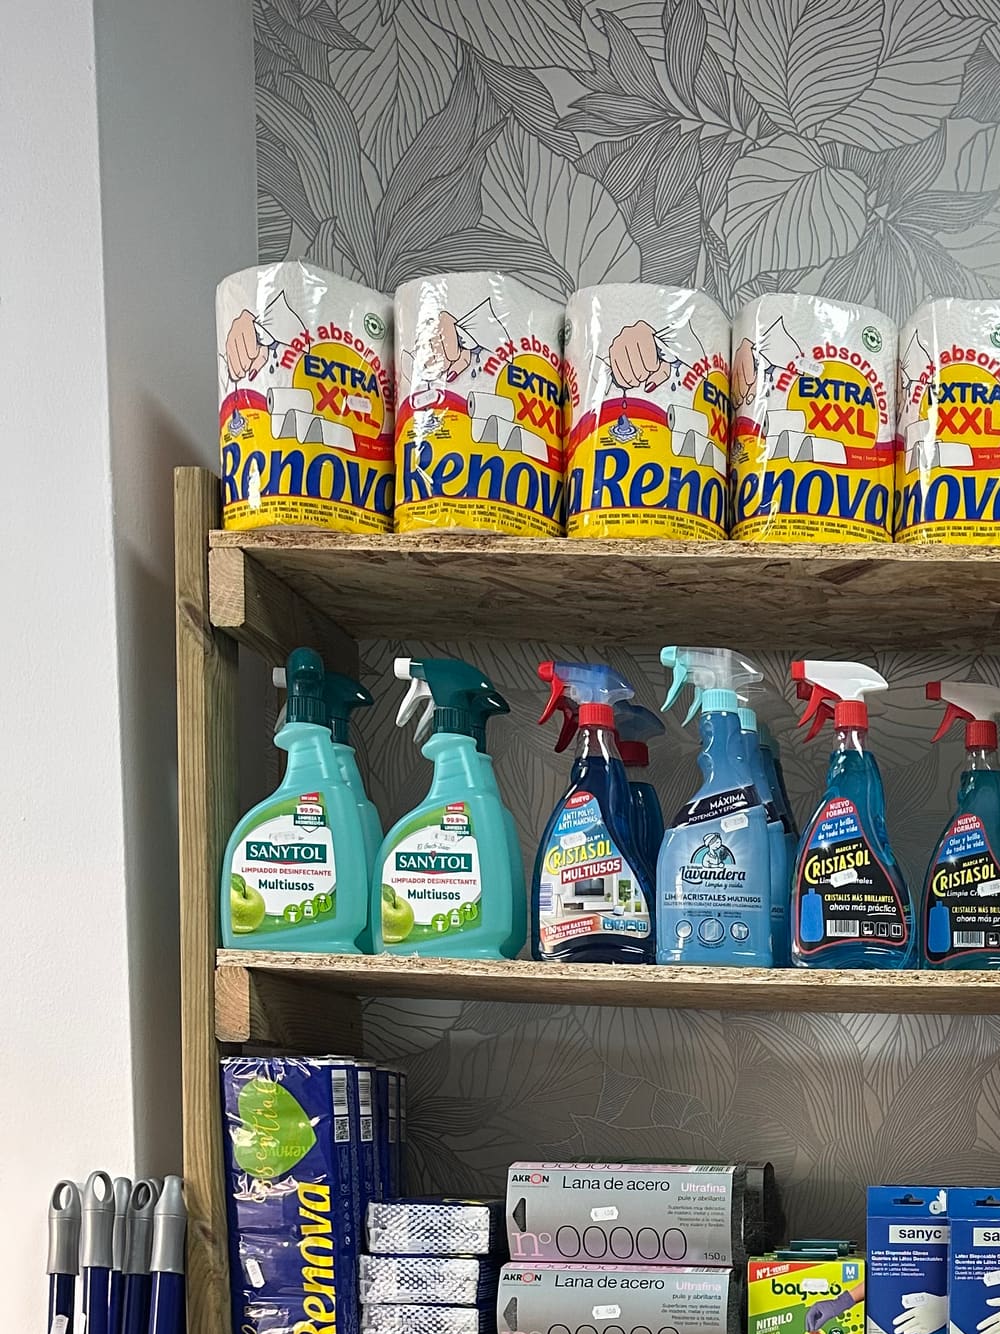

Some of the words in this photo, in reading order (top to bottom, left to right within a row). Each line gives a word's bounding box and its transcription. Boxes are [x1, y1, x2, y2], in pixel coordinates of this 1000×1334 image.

[279, 330, 313, 370] max
[304, 355, 380, 396] EXTRA
[710, 793, 746, 811] MÁXIMA
[954, 822, 980, 833] FORMATO
[958, 816, 976, 826] NUEVO
[249, 844, 323, 860] SANYTOL
[547, 842, 612, 874] CRISTASOL
[399, 856, 468, 869] SANYTOL
[805, 850, 870, 884] CRISTASOL
[280, 868, 332, 877] DESINFECTANTE
[562, 860, 621, 883] MULTIUSOS
[681, 867, 746, 884] Lavandera
[258, 879, 314, 891] Multiusos
[932, 863, 996, 896] CRISTASOL
[407, 889, 460, 900] Multiusos
[824, 894, 850, 902] CRISTALES
[866, 894, 894, 903] BRILLANTES
[868, 904, 896, 913] práctico
[512, 1173, 549, 1184] AKRON
[562, 1176, 601, 1190] Lana
[604, 1177, 622, 1190] de
[626, 1179, 669, 1191] acero
[681, 1183, 726, 1193] Ultrafina
[899, 1228, 942, 1240] sanyc
[503, 1273, 541, 1282] AKRON
[555, 1275, 593, 1288] Lana
[597, 1276, 617, 1288] de
[621, 1278, 664, 1289] acero
[756, 1313, 792, 1330] NITRILO
